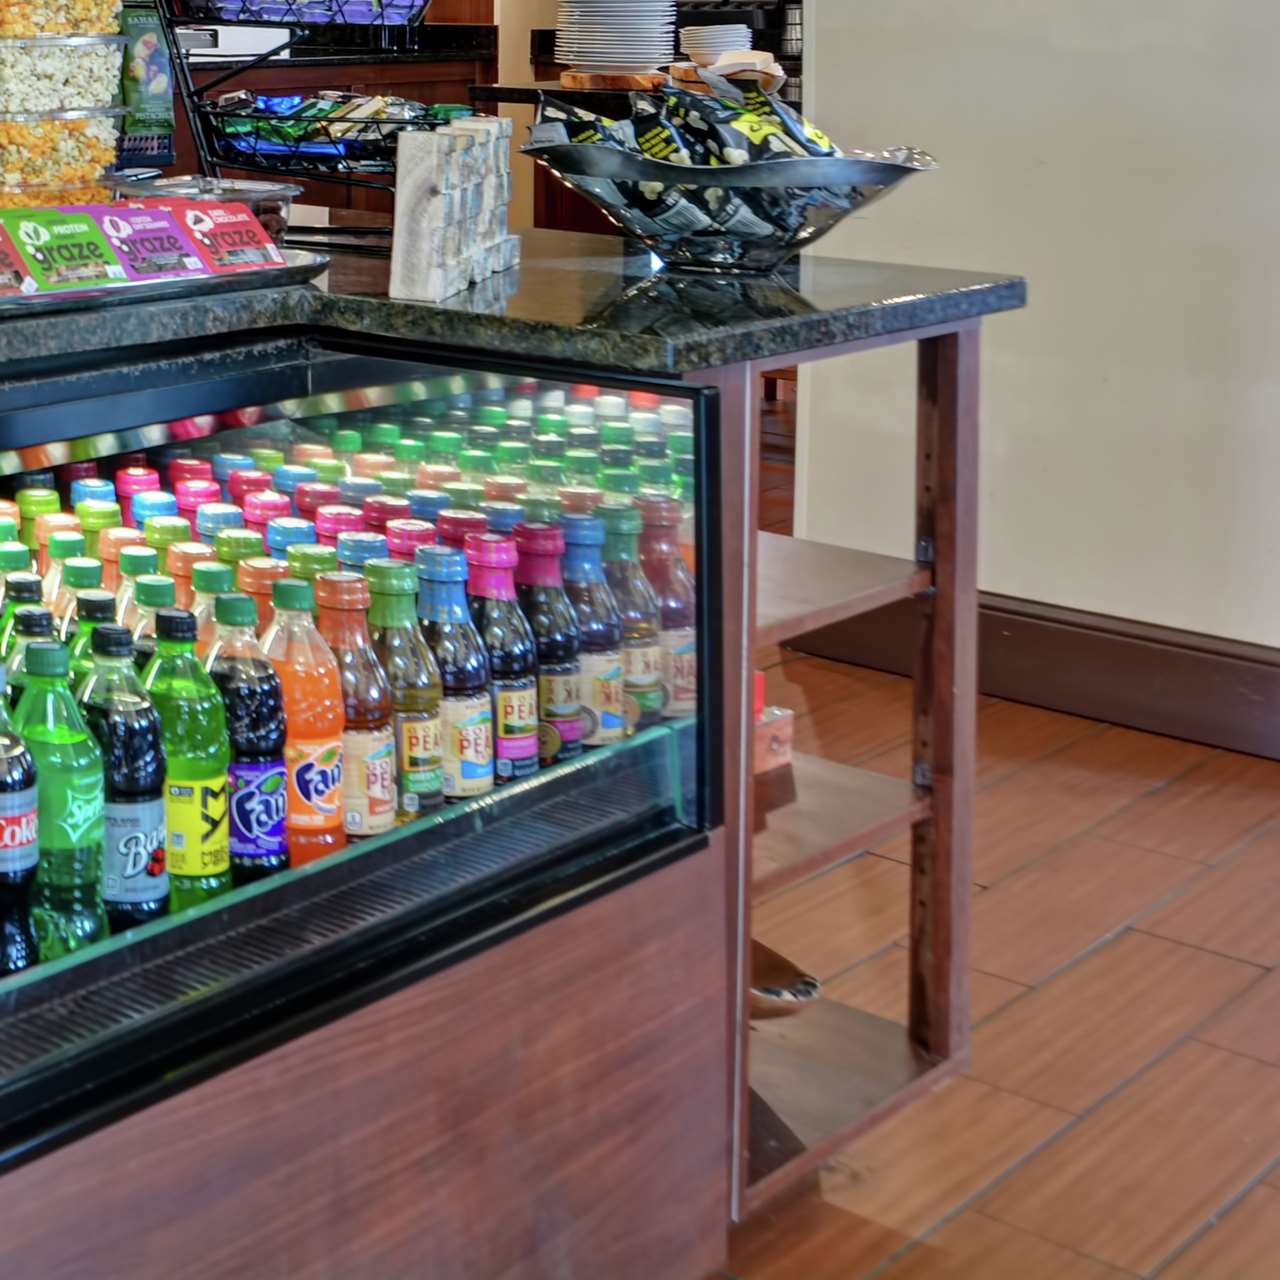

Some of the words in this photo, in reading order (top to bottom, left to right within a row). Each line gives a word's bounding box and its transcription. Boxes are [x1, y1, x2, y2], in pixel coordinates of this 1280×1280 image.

[52, 223, 89, 234] PROTEIN
[201, 229, 262, 256] graze
[33, 241, 105, 271] graze
[118, 234, 184, 263] graze
